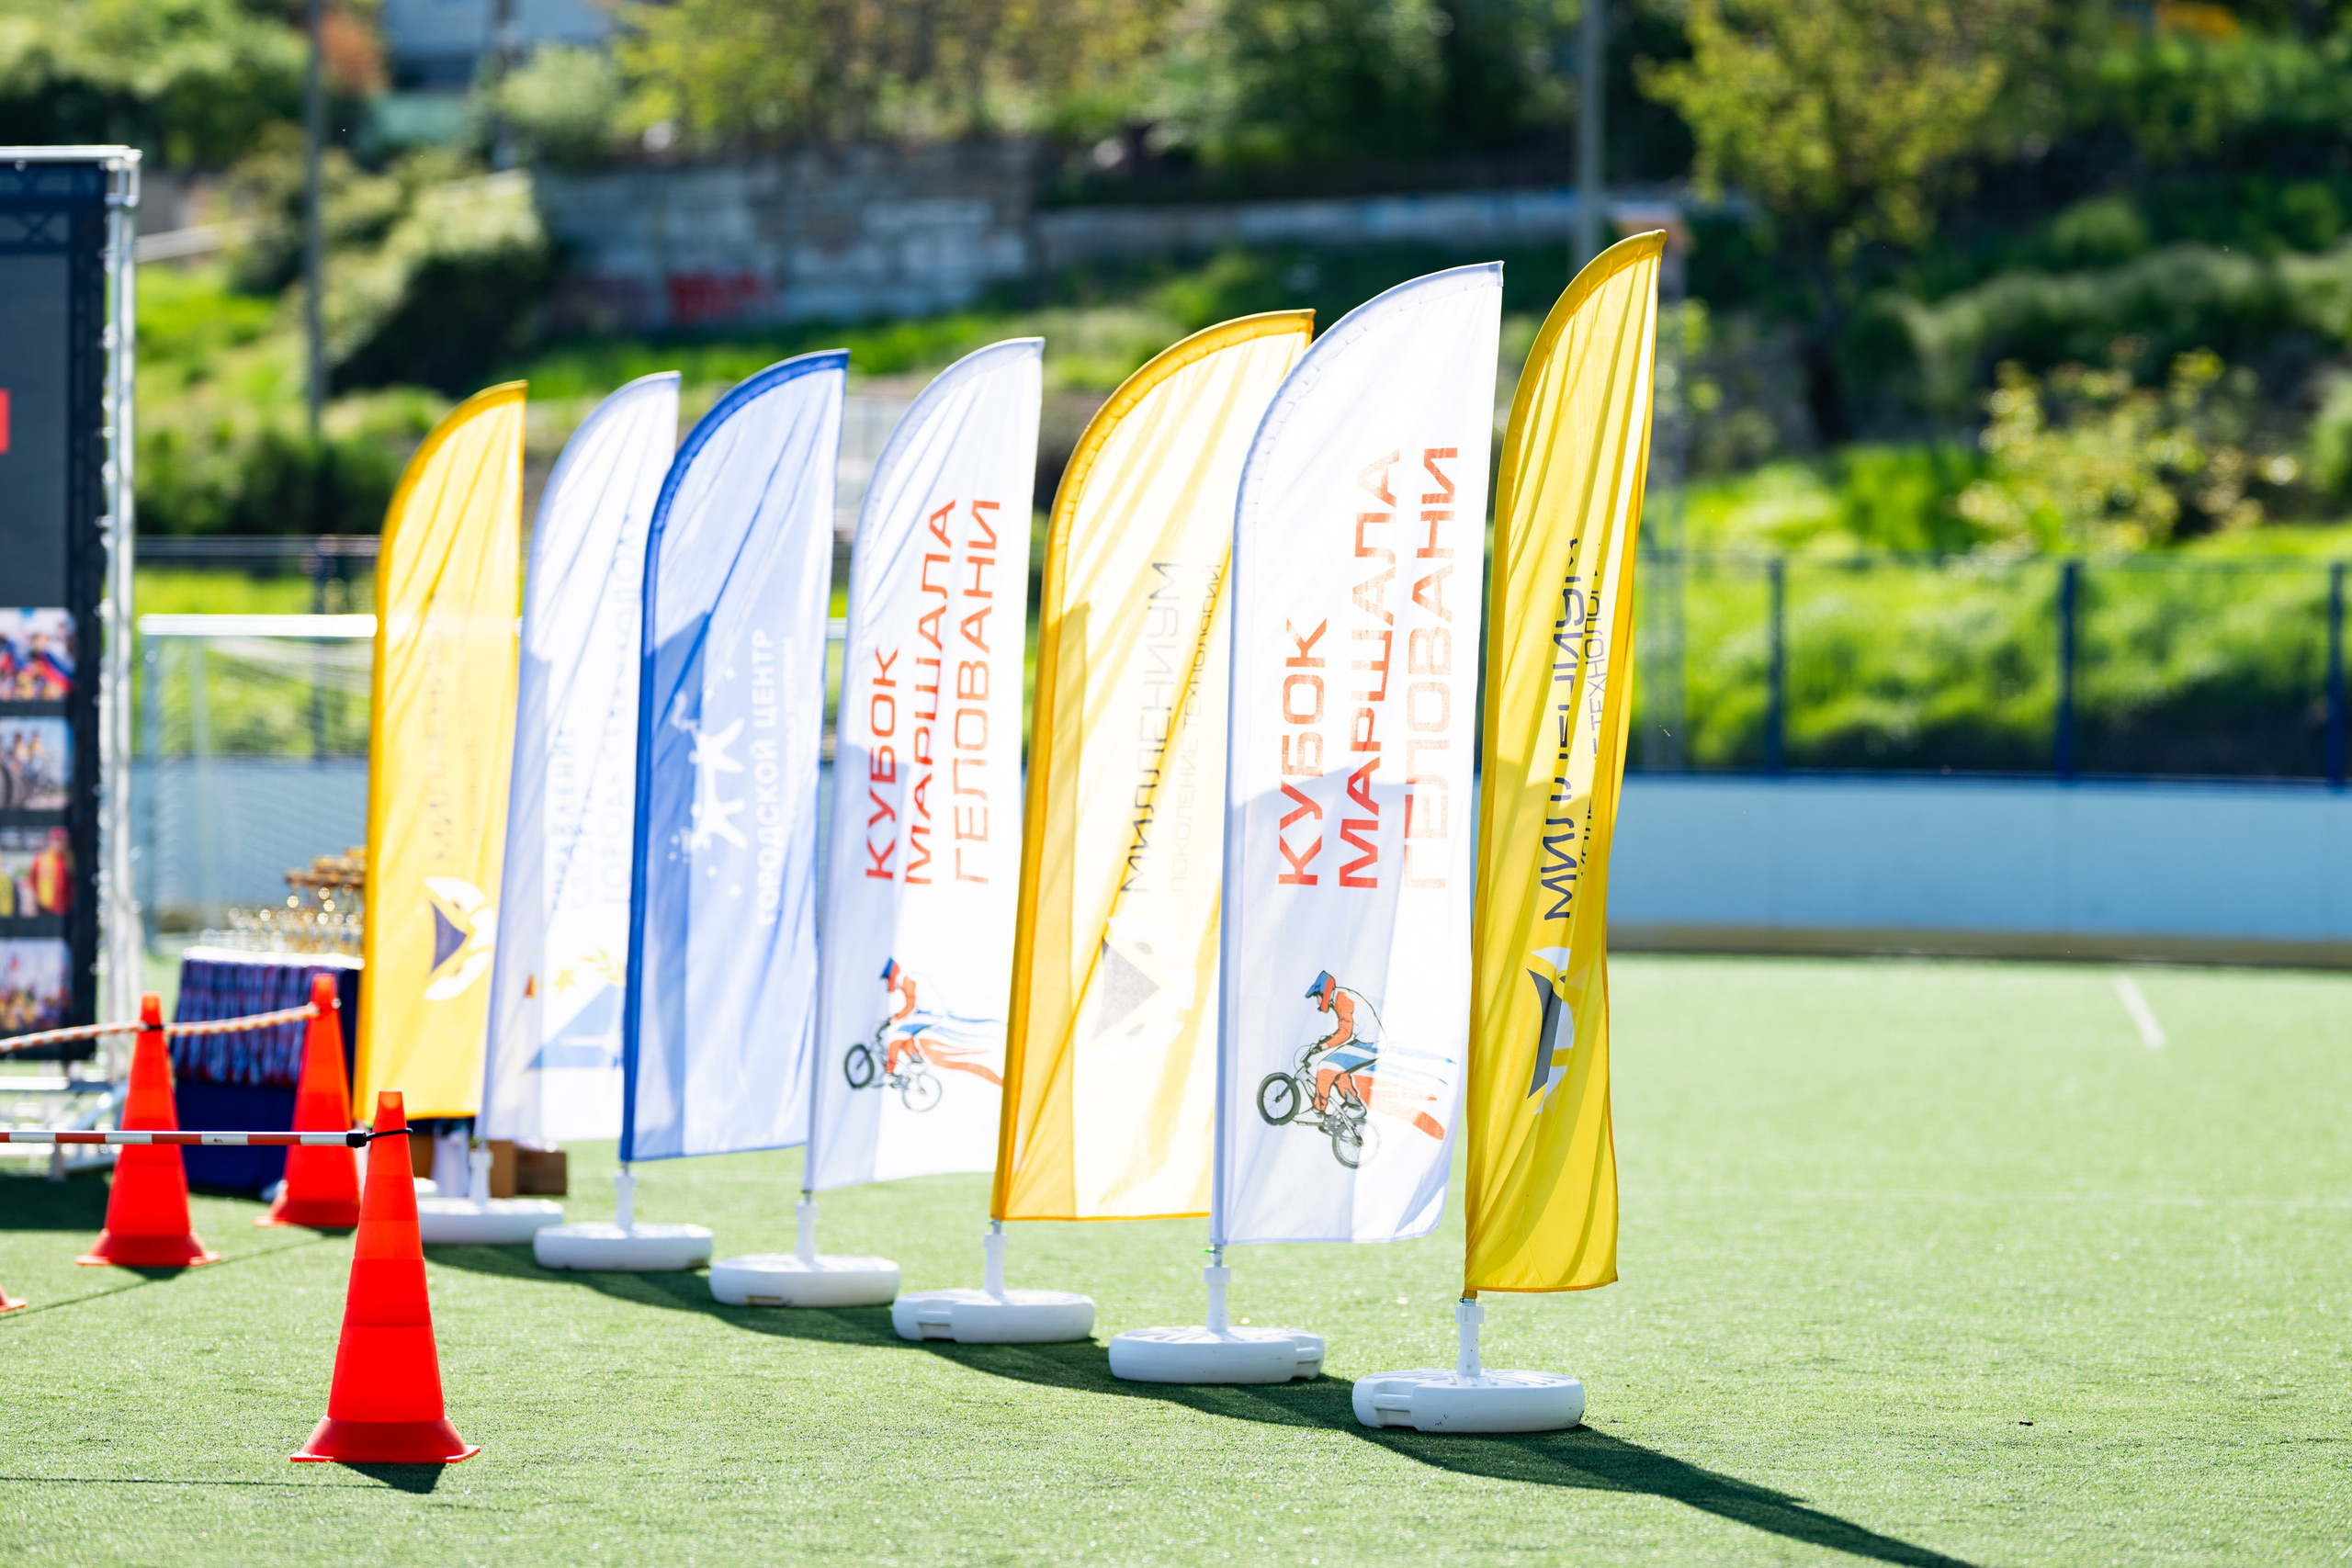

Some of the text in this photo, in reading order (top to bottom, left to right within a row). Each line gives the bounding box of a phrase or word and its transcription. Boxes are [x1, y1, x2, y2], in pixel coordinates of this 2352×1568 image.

[749, 627, 786, 927] ГОРОДСКОЙ ЦЕНТР
[865, 646, 899, 880] КУБОК
[905, 500, 956, 885] МАРШАЛА
[953, 500, 1001, 885] ГЕЛОВАНИ
[1120, 562, 1183, 893] МИЛЛЕНИУМ
[1278, 616, 1327, 886] КУБОК
[1339, 448, 1399, 888] МАРШАЛА
[1403, 447, 1458, 889] ГЕЛОВАНИ
[1583, 543, 1607, 731] ТЕХНОЛО
